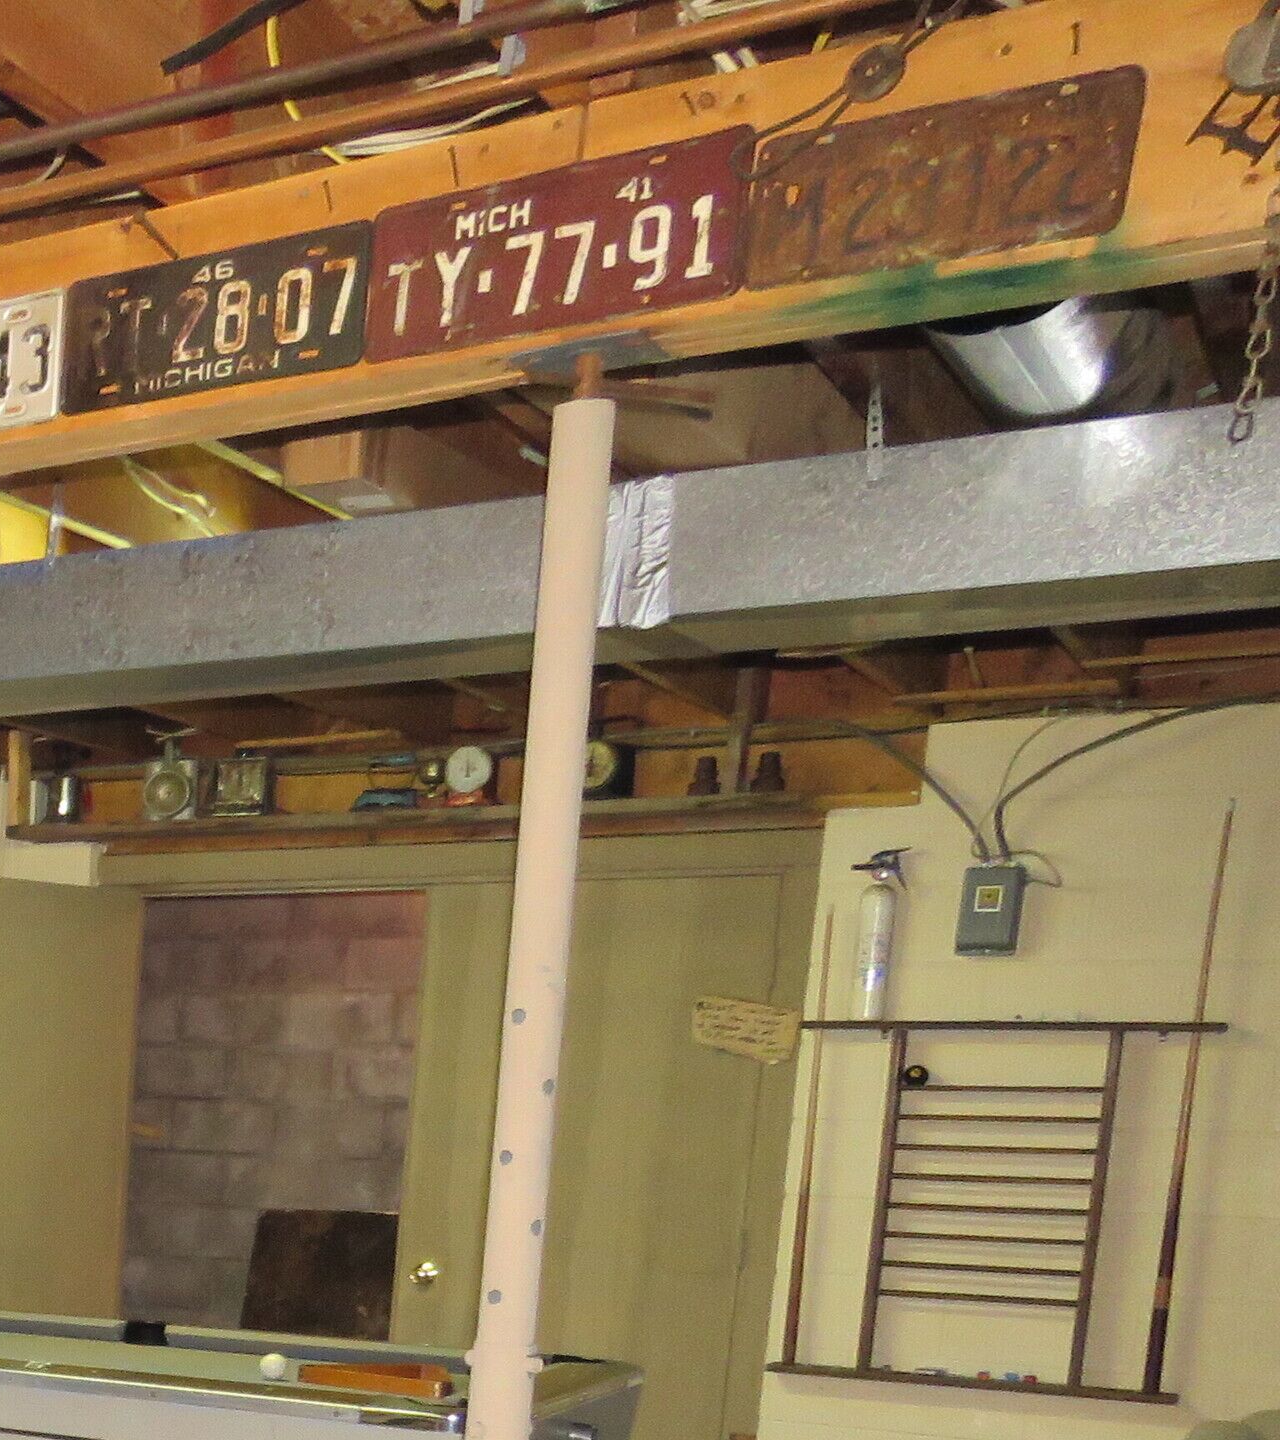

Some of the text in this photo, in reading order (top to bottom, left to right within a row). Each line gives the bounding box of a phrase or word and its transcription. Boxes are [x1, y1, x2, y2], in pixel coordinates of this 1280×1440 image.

[615, 177, 654, 202] 41
[192, 259, 234, 283] 46
[134, 350, 280, 396] MICHIGAN
